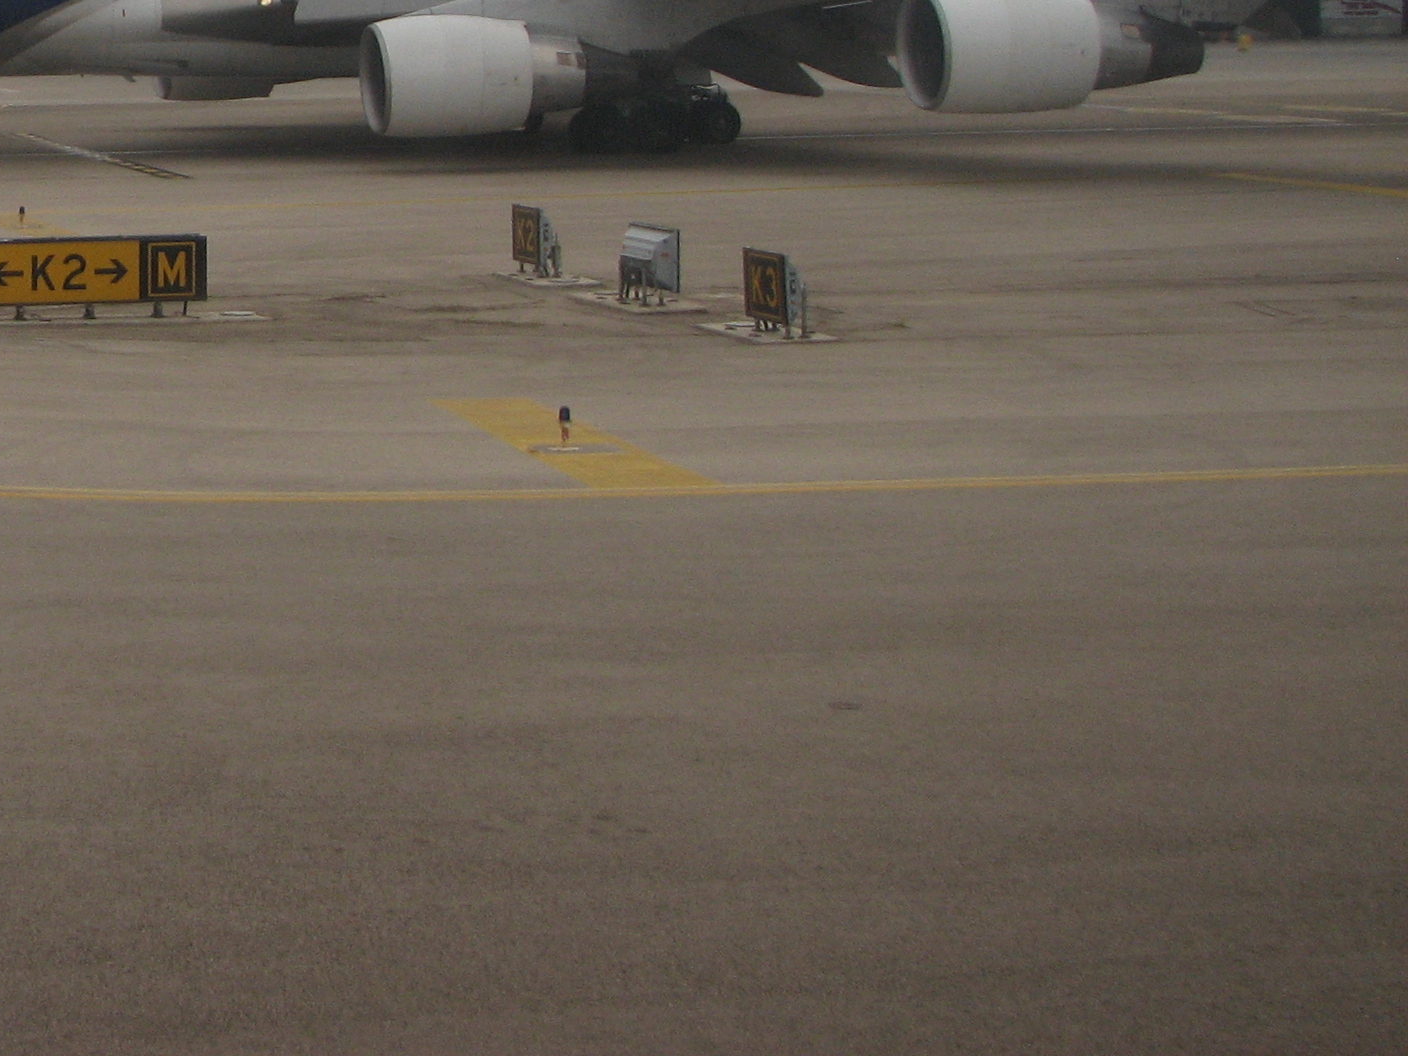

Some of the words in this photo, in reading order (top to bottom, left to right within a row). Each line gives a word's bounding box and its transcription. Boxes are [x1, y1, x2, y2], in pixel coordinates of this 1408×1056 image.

[31, 254, 87, 291] K2
[157, 251, 187, 288] M
[750, 264, 779, 307] K3
